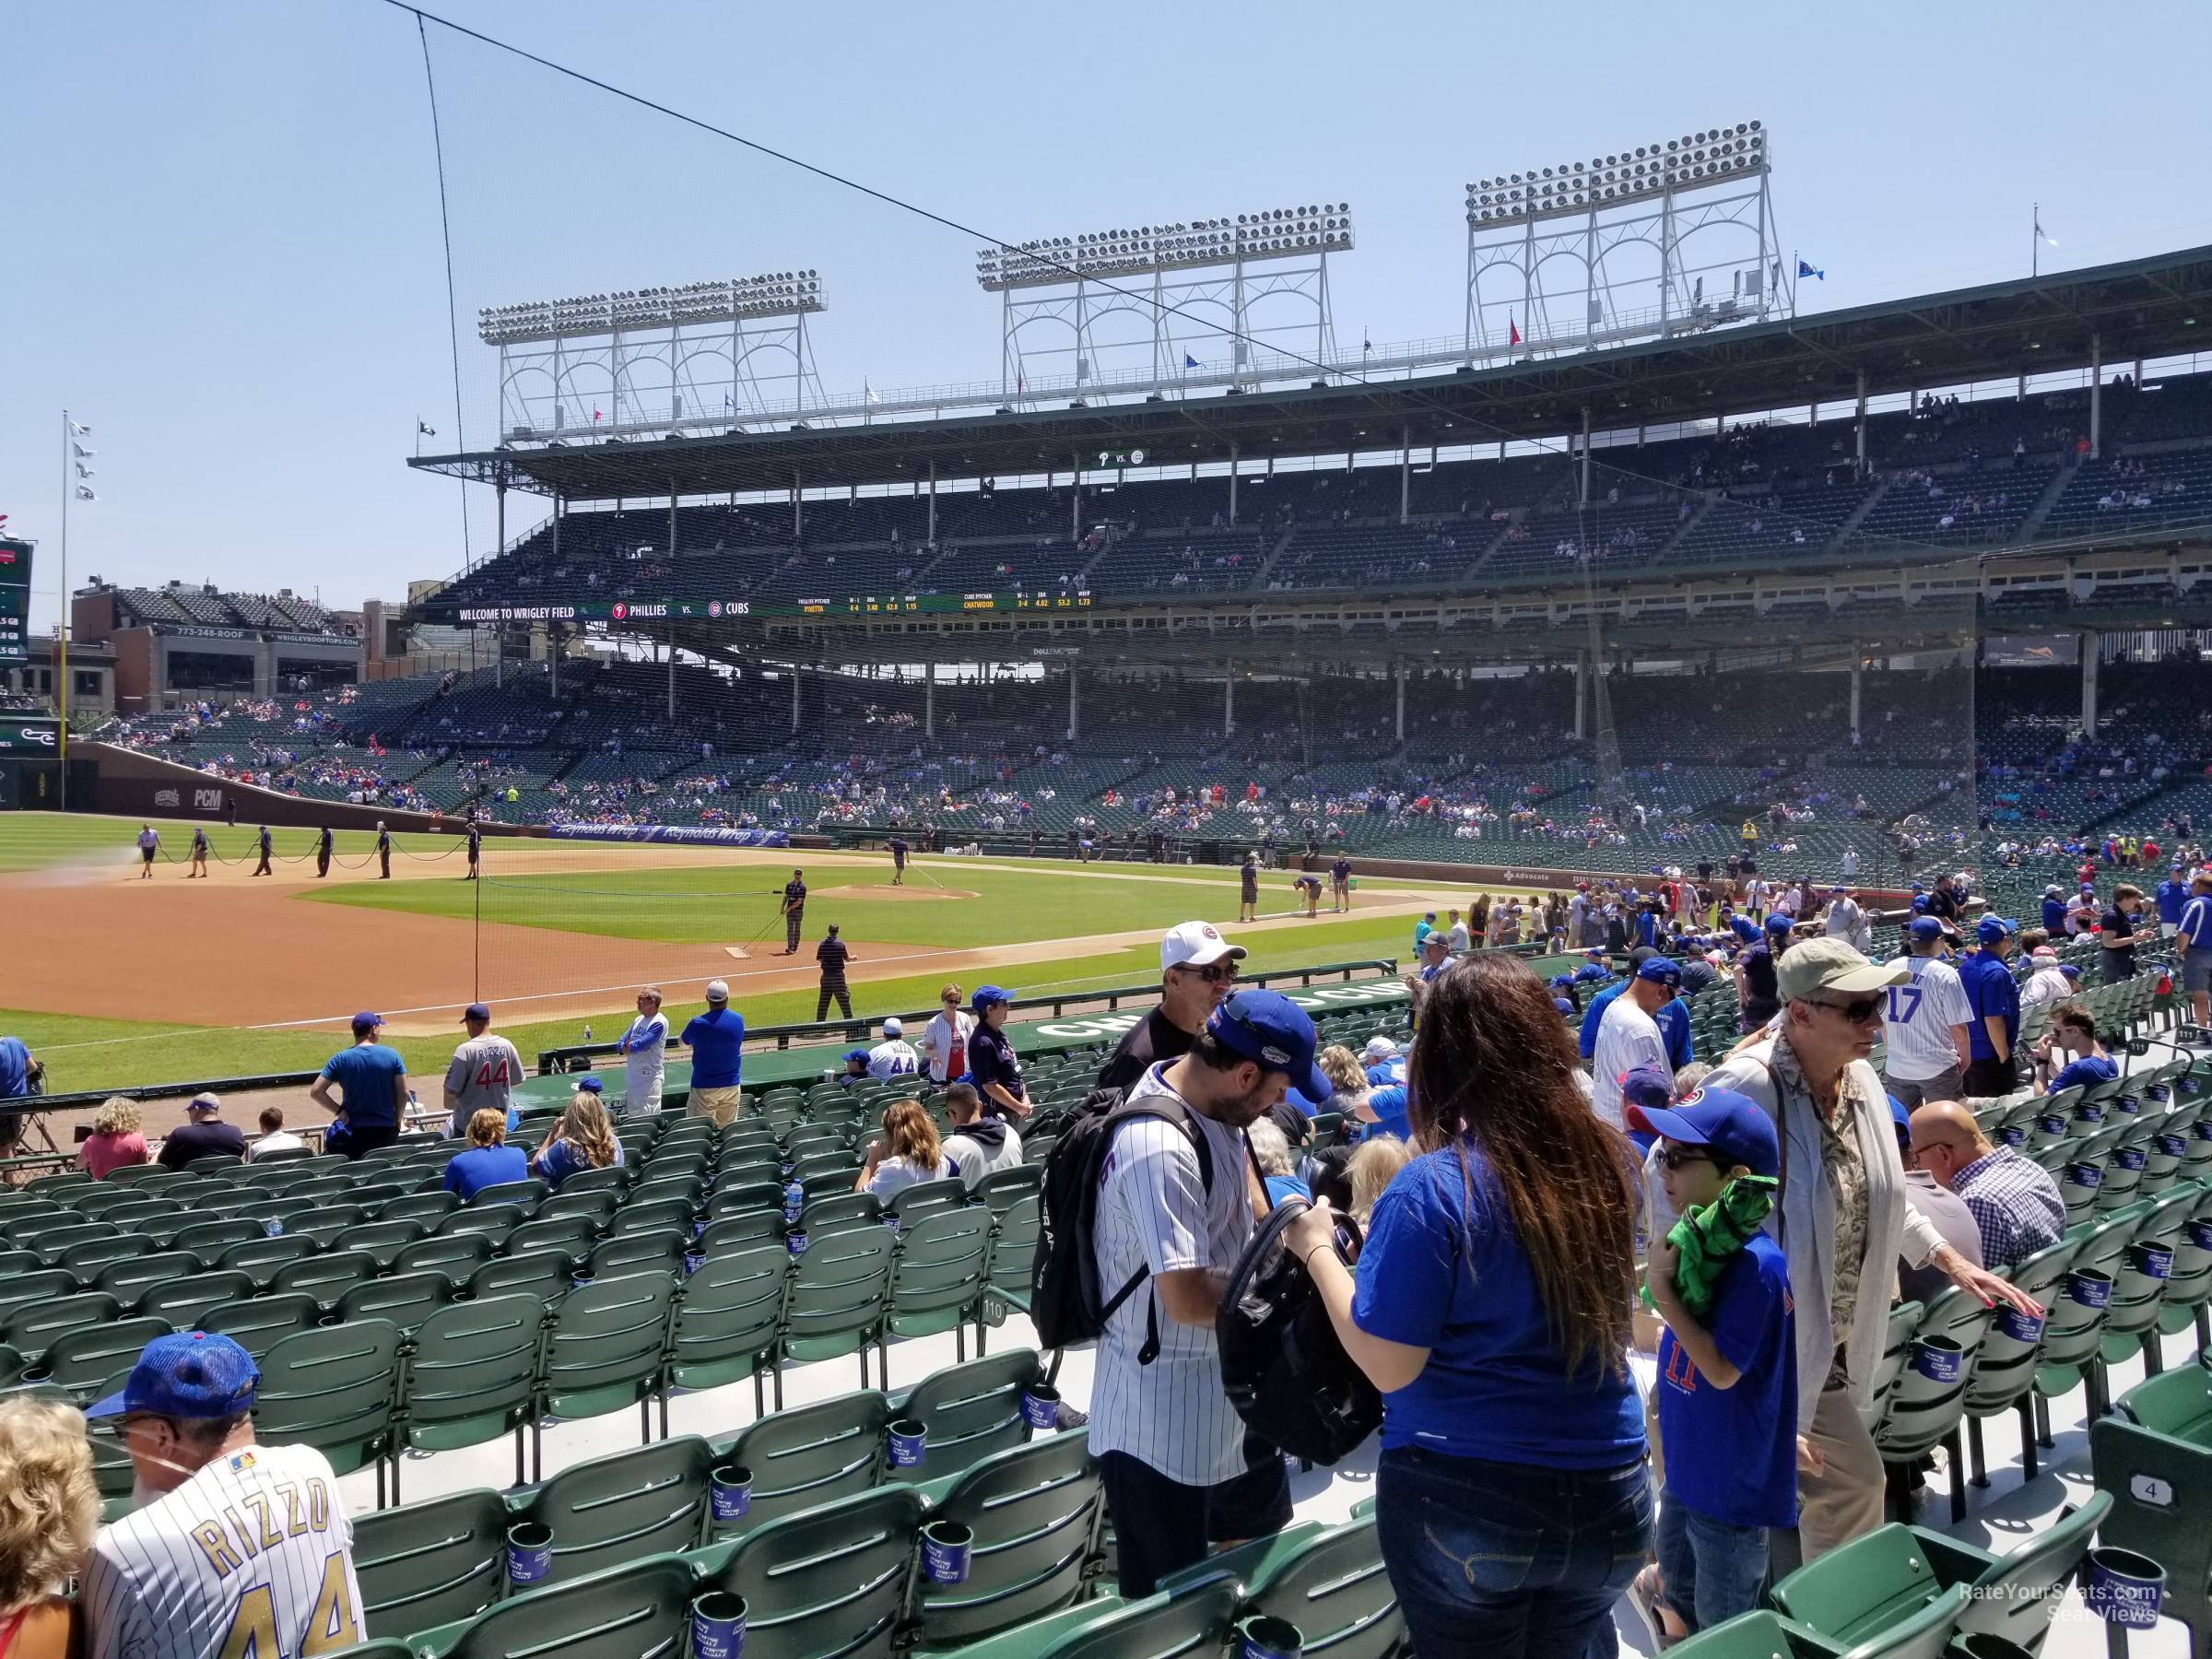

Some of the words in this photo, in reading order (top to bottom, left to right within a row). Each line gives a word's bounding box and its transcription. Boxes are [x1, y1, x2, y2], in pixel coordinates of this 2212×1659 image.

[460, 609, 499, 620] WELCOME
[501, 609, 511, 619] TO
[514, 607, 550, 619] WRIGLEY
[552, 607, 575, 618] FIELD
[630, 605, 667, 616] PHILLIES
[726, 602, 749, 614] CUBS
[177, 628, 243, 638] 773-248-ROOF
[277, 634, 359, 645] WRIGLEYROOFTOPS.COM
[194, 789, 222, 807] PCM
[606, 825, 639, 839] Wrap
[663, 827, 719, 840] Reynolds
[718, 829, 752, 843] Wrap
[1515, 872, 1549, 881] Advocate
[1888, 987, 1922, 1024] 17
[2131, 1043, 2144, 1051] 111
[890, 1057, 915, 1074] 44
[475, 1059, 509, 1091] 44
[984, 1299, 1002, 1318] 110
[1666, 1341, 1696, 1392] 11
[2145, 1483, 2157, 1499] 4
[190, 1477, 329, 1579] RIZZO
[930, 1557, 951, 1570] Hefty
[512, 1571, 531, 1579] Hefty
[936, 1570, 958, 1579] Hefty
[218, 1549, 359, 1659] 44
[697, 1632, 718, 1646] Hefty
[702, 1647, 728, 1657] Hefty
